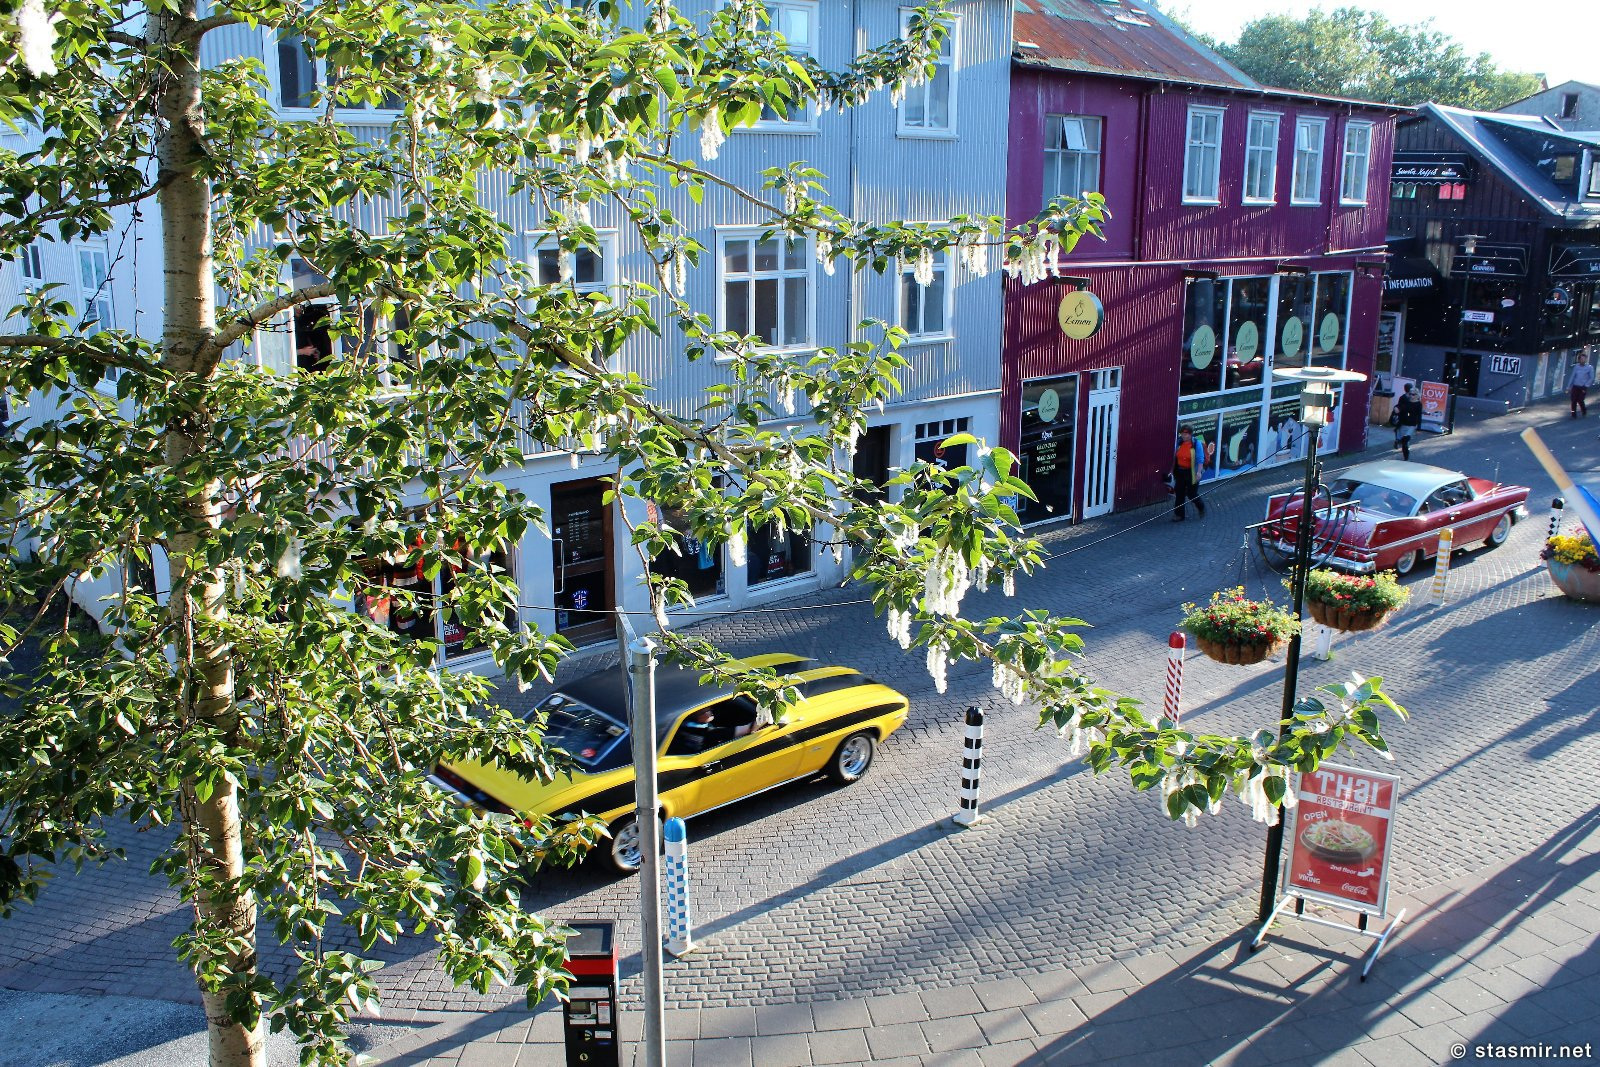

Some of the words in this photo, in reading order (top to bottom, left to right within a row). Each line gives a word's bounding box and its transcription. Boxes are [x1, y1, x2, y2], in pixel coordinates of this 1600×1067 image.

[1389, 277, 1433, 290] INFORMATION
[1064, 315, 1092, 325] Lemon
[1493, 356, 1520, 374] FLASH
[1422, 388, 1445, 399] LOW
[1303, 810, 1328, 821] OPEN
[1329, 864, 1342, 872] 2nd
